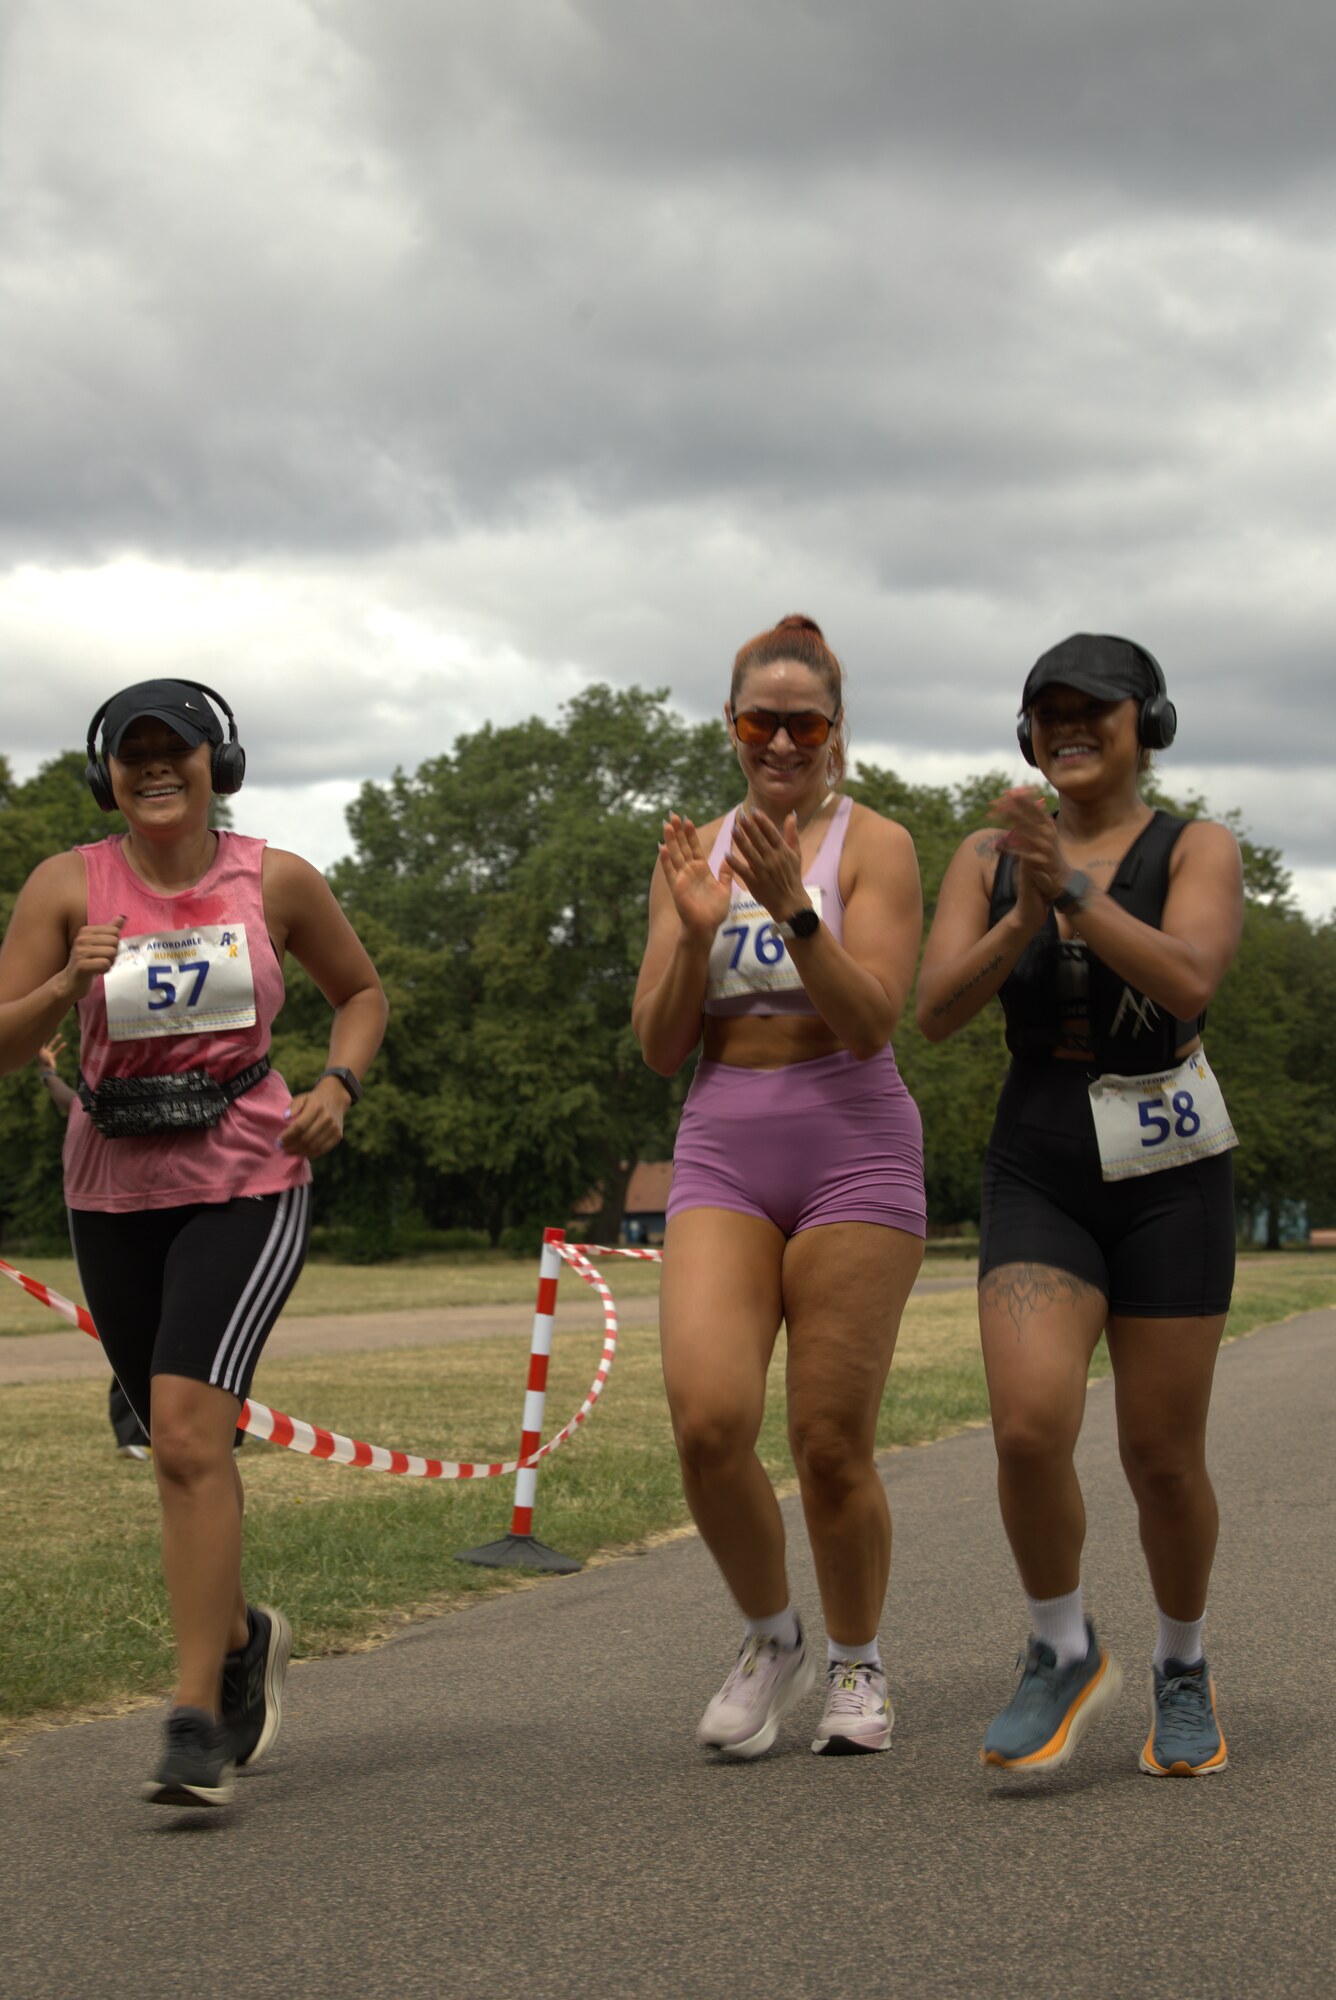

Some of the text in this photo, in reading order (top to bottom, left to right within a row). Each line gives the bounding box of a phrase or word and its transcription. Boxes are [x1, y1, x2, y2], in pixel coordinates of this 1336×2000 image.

[147, 937, 203, 951] AFFORDABLE
[154, 949, 197, 960] RUNNING
[722, 921, 785, 969] 76
[147, 960, 210, 1011] 57
[1137, 1090, 1201, 1147] 58
